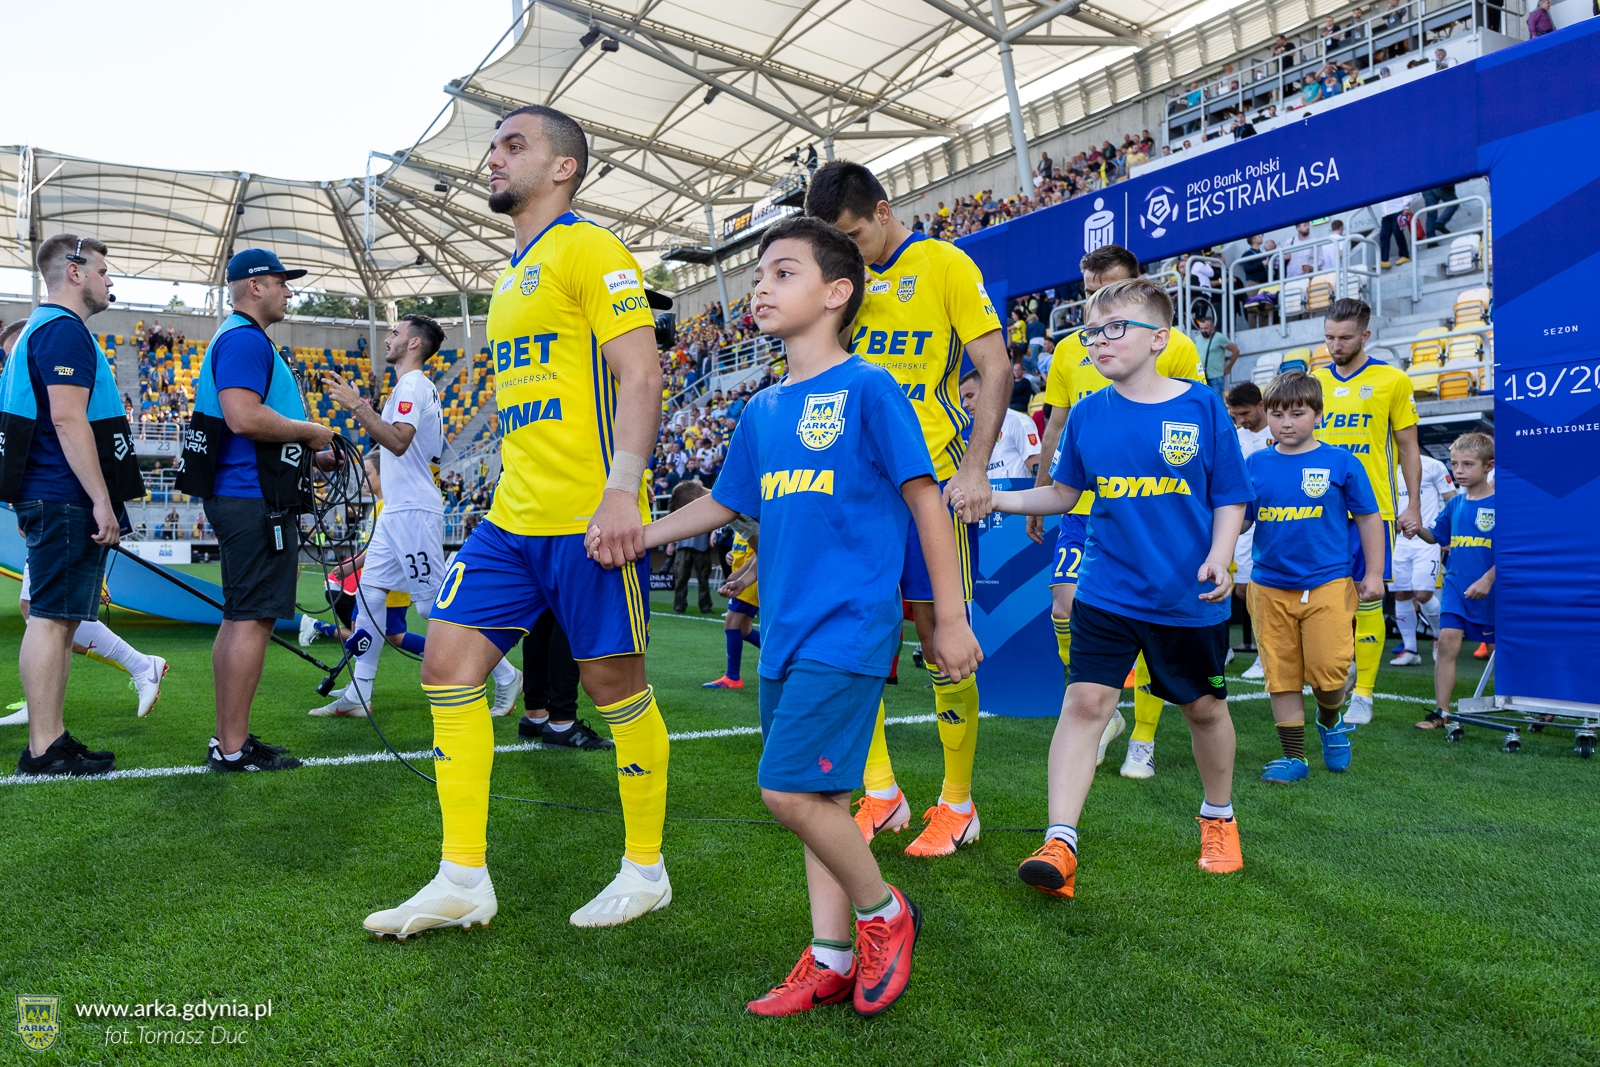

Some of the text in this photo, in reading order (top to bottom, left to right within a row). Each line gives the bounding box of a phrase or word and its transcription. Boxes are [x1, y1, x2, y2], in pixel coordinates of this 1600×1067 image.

[1187, 157, 1279, 197] PKO Bank Polski
[1186, 157, 1340, 223] EKSTRAKLASA
[1543, 325, 1578, 336] SEZON
[490, 332, 558, 374] BET
[1504, 364, 1600, 401] 19/2
[1516, 423, 1600, 437] #NASTADIONIE
[157, 441, 171, 451] 23
[1167, 444, 1192, 452] ARKA
[1097, 476, 1192, 498] GDYNIA
[1258, 506, 1323, 522] GDYNIA
[406, 551, 431, 579] 33
[1054, 547, 1082, 578] 22
